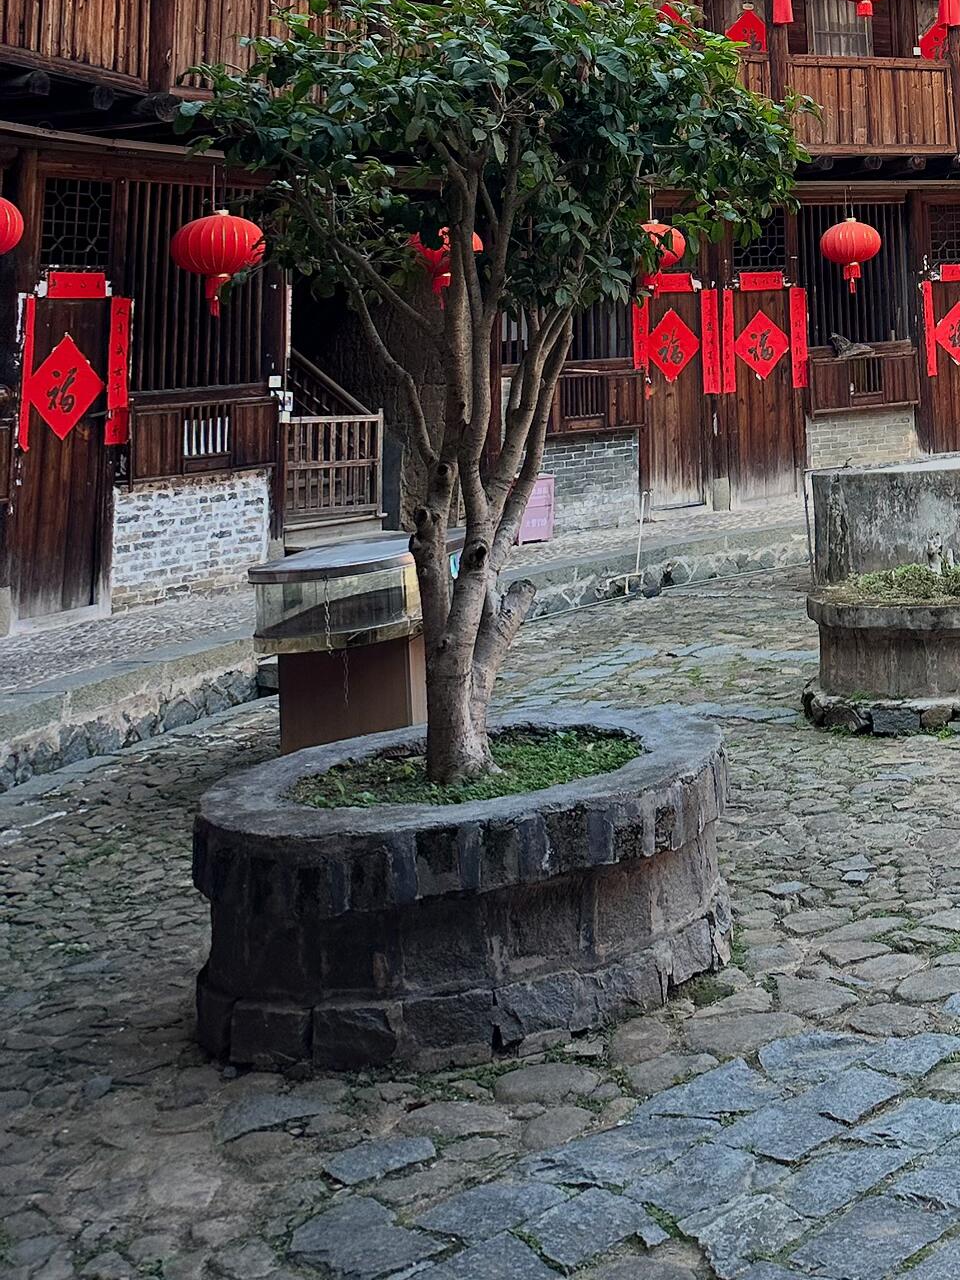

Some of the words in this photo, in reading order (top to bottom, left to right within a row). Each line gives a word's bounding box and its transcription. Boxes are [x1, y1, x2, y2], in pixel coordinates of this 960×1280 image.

[658, 327, 684, 365] 福
[747, 328, 775, 362] 福
[46, 367, 78, 414] 福
